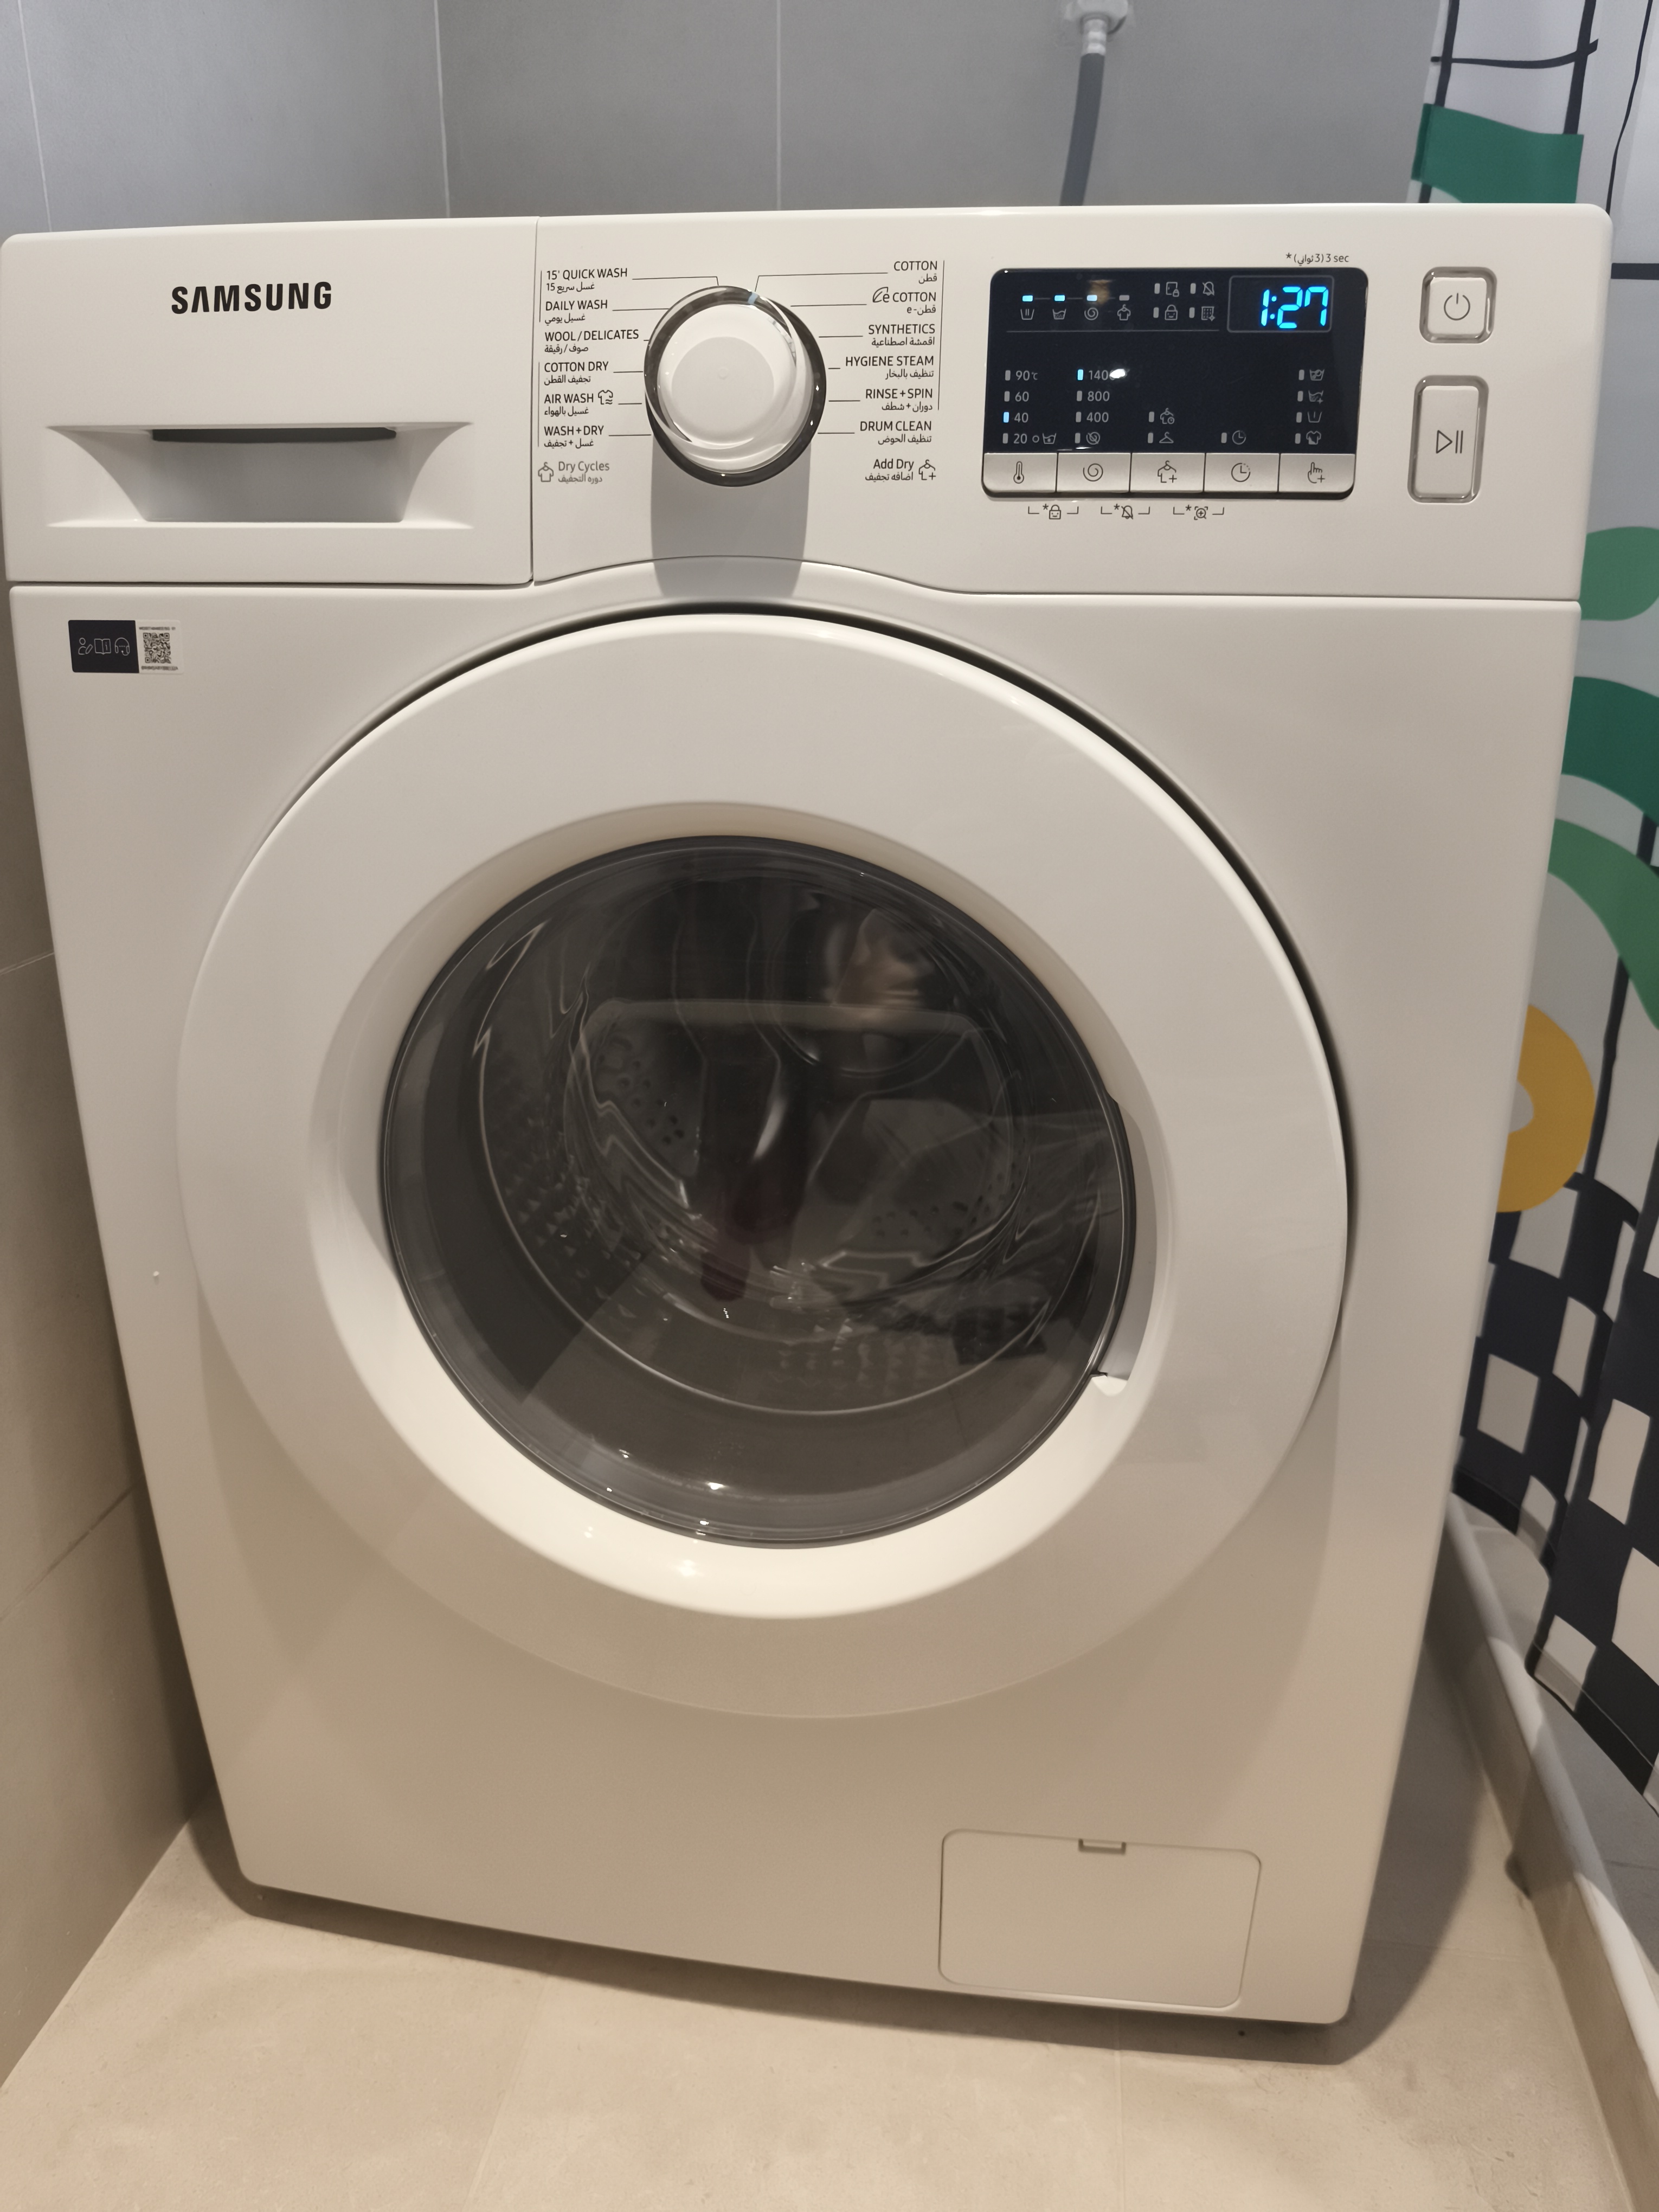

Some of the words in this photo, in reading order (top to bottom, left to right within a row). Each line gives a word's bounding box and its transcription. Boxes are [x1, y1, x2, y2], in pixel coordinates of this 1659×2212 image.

[893, 261, 937, 271] COTTON
[563, 269, 595, 281] QUICK
[597, 268, 627, 278] WASH
[918, 273, 937, 284] قطن
[557, 285, 575, 294] سريع
[576, 282, 595, 292] غسل
[171, 281, 331, 314] SAMSUNG
[892, 292, 936, 302] COTTON
[545, 301, 575, 311] DAILY
[577, 300, 608, 309] WASH
[1261, 286, 1328, 329] 1:27
[545, 317, 562, 326] يومي
[564, 313, 586, 323] غسيل
[869, 324, 935, 335] SYNTHETICS
[871, 337, 907, 348] اصطناعية
[846, 356, 893, 366] HYGIENE
[897, 356, 934, 366] STEAM
[544, 362, 584, 372] COTTON
[588, 362, 609, 371] DRY
[885, 369, 908, 380] بالبخار
[910, 369, 934, 379] تنظيف
[1089, 370, 1115, 381] 140
[544, 375, 565, 385] القطن
[568, 375, 591, 384] تجفيف
[544, 394, 561, 403] AIR
[564, 394, 594, 403] WASH
[1015, 391, 1029, 402] 60
[1087, 391, 1110, 402] 800
[544, 406, 565, 417] بالهواء
[568, 406, 589, 416] غسيل
[1014, 413, 1028, 423] 40
[1086, 412, 1109, 422] 400
[860, 421, 893, 431] DRUM
[895, 421, 931, 431] CLEAN
[878, 434, 905, 445] الحوض
[908, 434, 931, 445] تنظيف
[1014, 434, 1027, 444] 20
[558, 461, 575, 473] Dry
[578, 460, 609, 473] Cycles
[873, 458, 893, 469] Add
[897, 459, 914, 471] Dry
[865, 473, 889, 483] تجفيف
